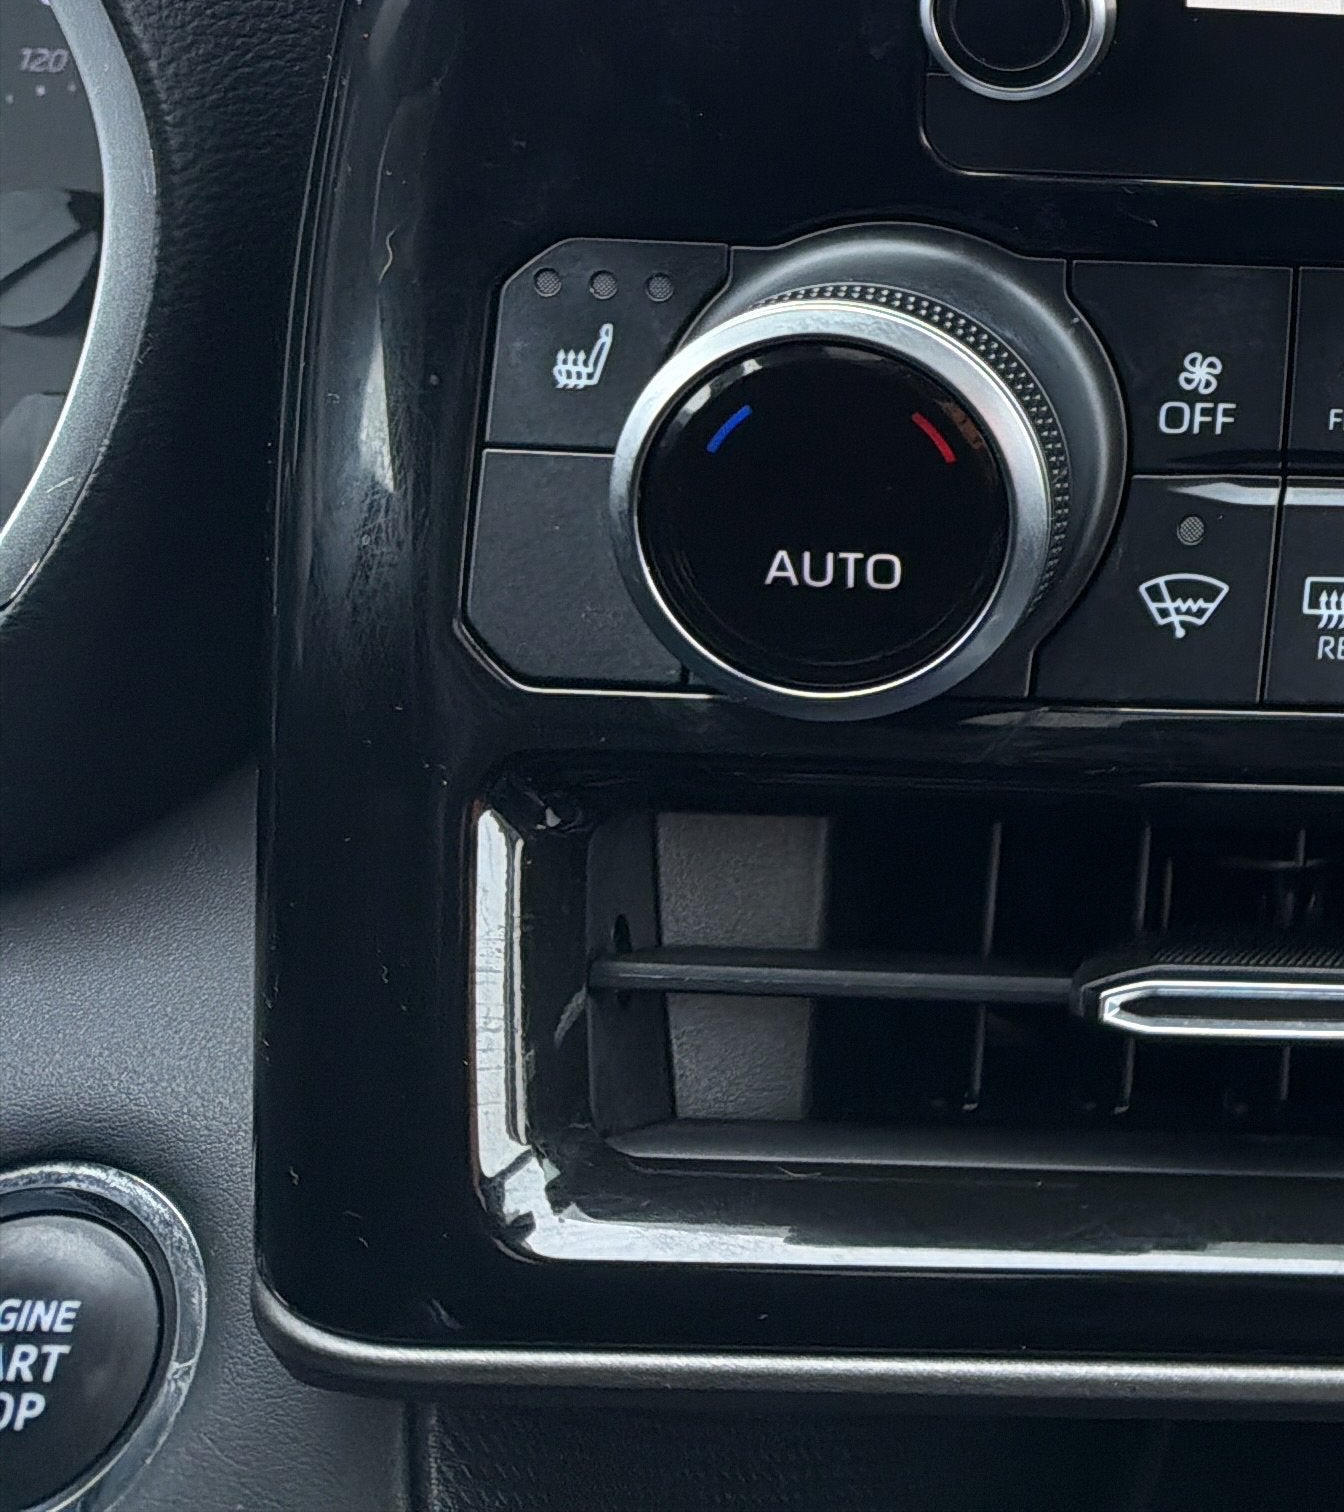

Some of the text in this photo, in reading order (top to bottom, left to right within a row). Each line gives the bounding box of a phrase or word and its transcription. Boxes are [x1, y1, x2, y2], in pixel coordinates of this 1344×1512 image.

[20, 47, 69, 73] 120
[1157, 400, 1238, 436] OFF
[763, 548, 903, 591] AUTO
[0, 1343, 72, 1383] RT
